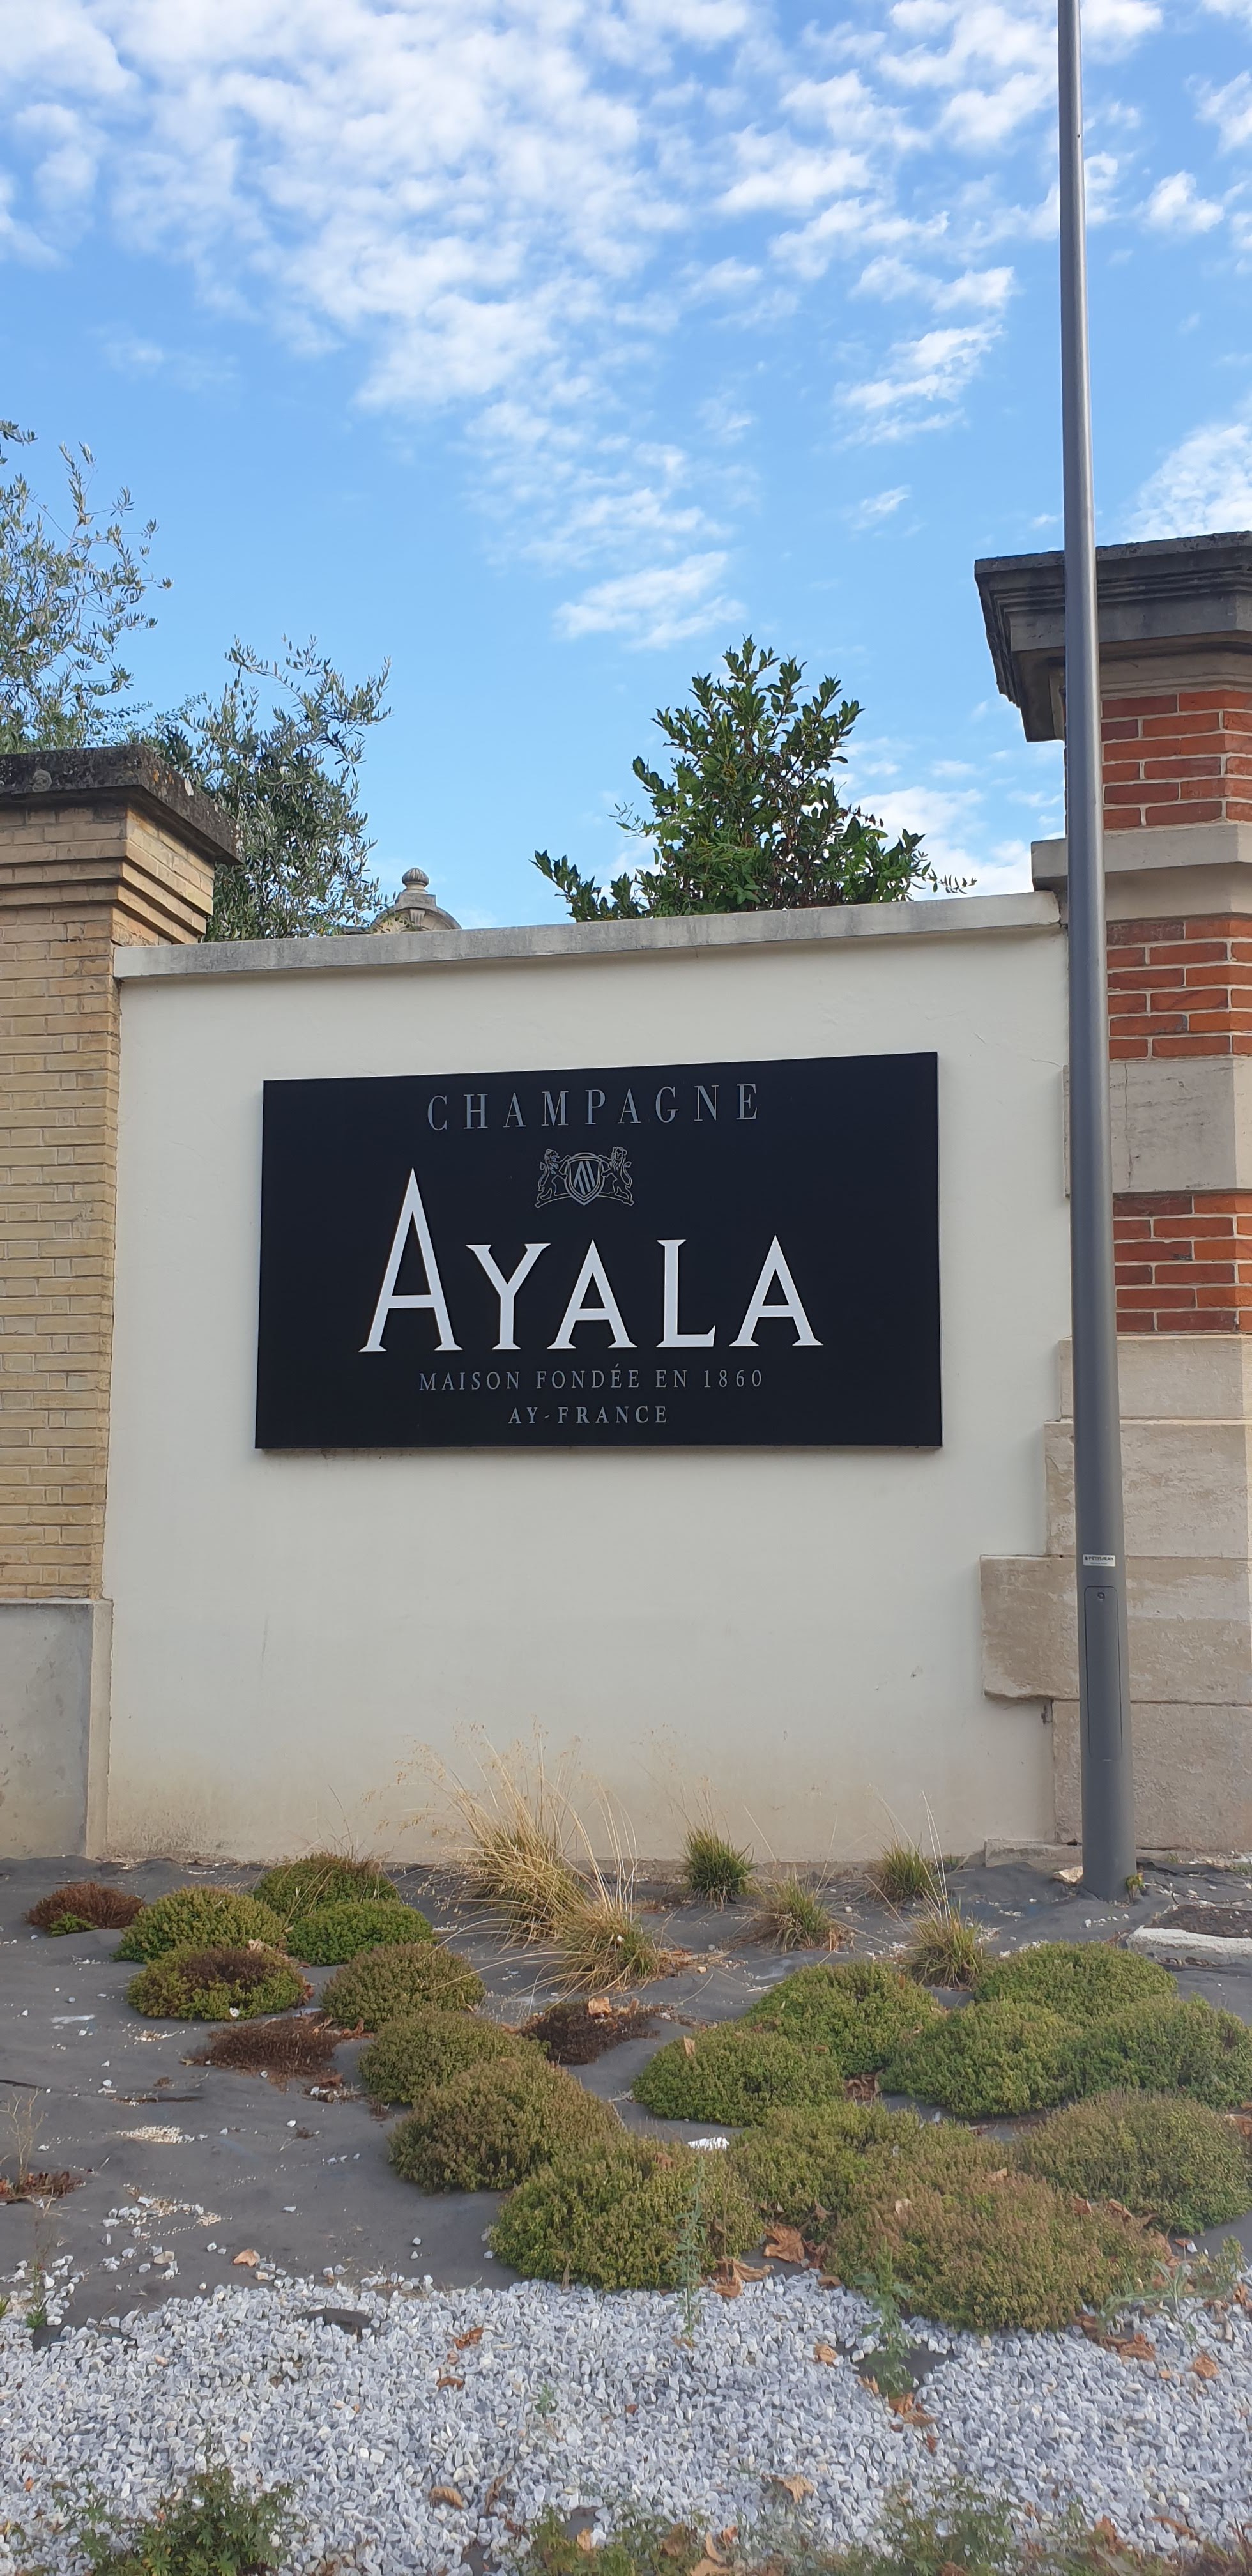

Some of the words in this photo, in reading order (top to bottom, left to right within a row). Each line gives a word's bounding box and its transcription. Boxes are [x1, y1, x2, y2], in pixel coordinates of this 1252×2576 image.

[427, 1083, 759, 1131] CHAMPAGNE
[358, 1167, 824, 1353] AYALA
[419, 1370, 521, 1391] MAISON
[535, 1363, 640, 1389] FONDÉE
[655, 1369, 688, 1388] EN
[703, 1369, 762, 1388] 1860
[508, 1405, 667, 1424] AY-FRANCE
